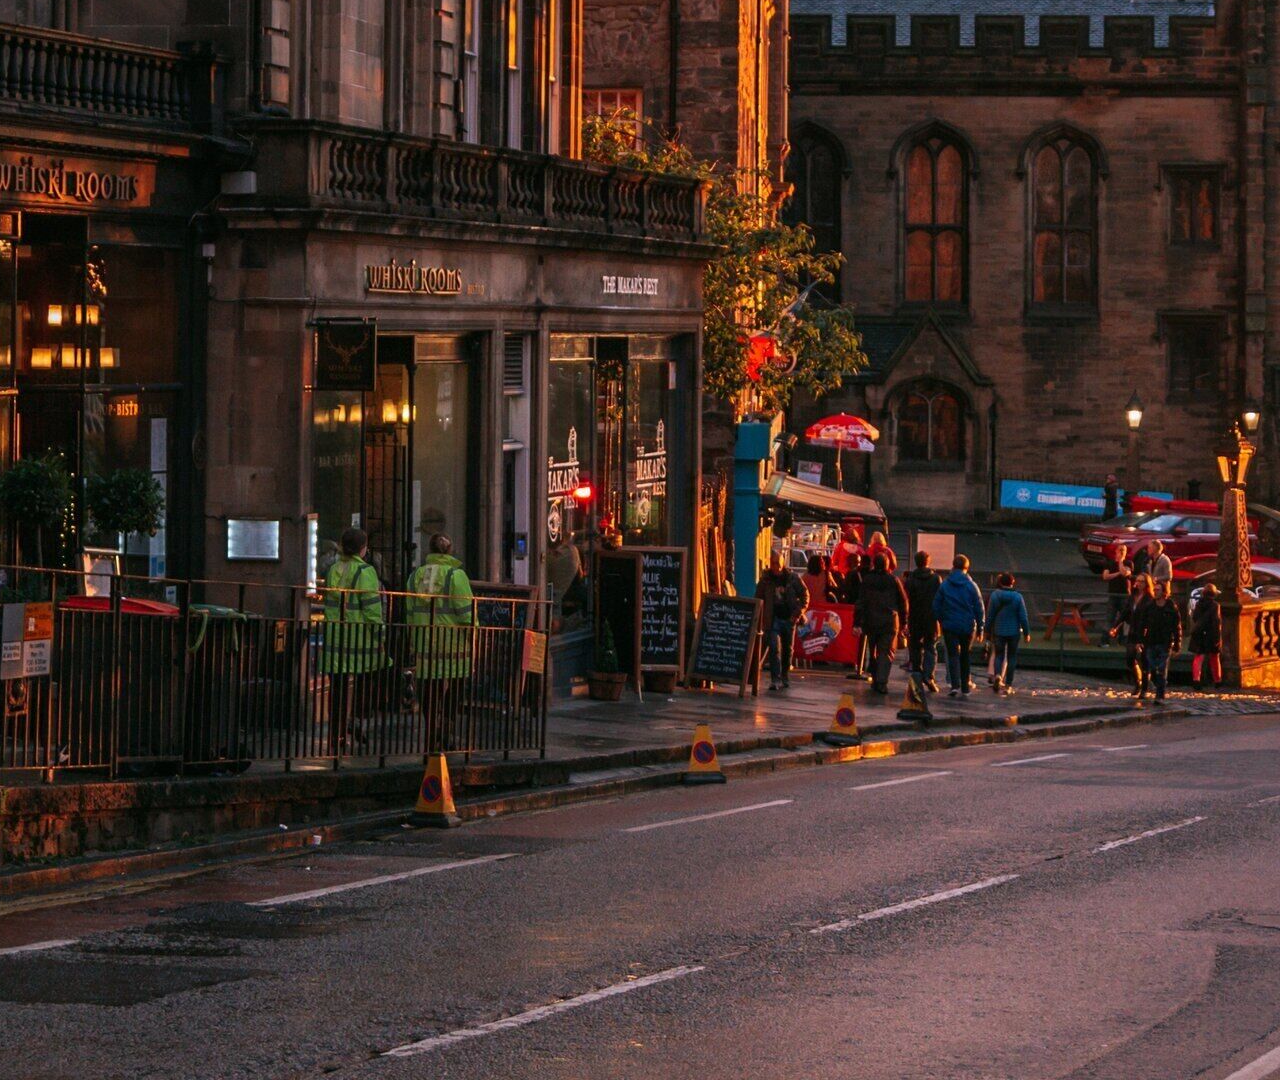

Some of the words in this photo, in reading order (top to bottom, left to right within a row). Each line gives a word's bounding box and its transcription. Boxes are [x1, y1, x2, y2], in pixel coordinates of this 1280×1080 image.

[75, 170, 139, 203] ROOMS
[367, 258, 416, 293] WHISKI
[420, 268, 463, 294] ROOMS
[602, 274, 616, 294] THE
[617, 274, 643, 295] MAKAR'S
[644, 277, 660, 296] REST
[547, 466, 580, 495] AKAR'S
[636, 457, 667, 481] MAKAR'S
[1037, 493, 1076, 506] EDINBURGH
[1077, 497, 1106, 509] FESTIVA
